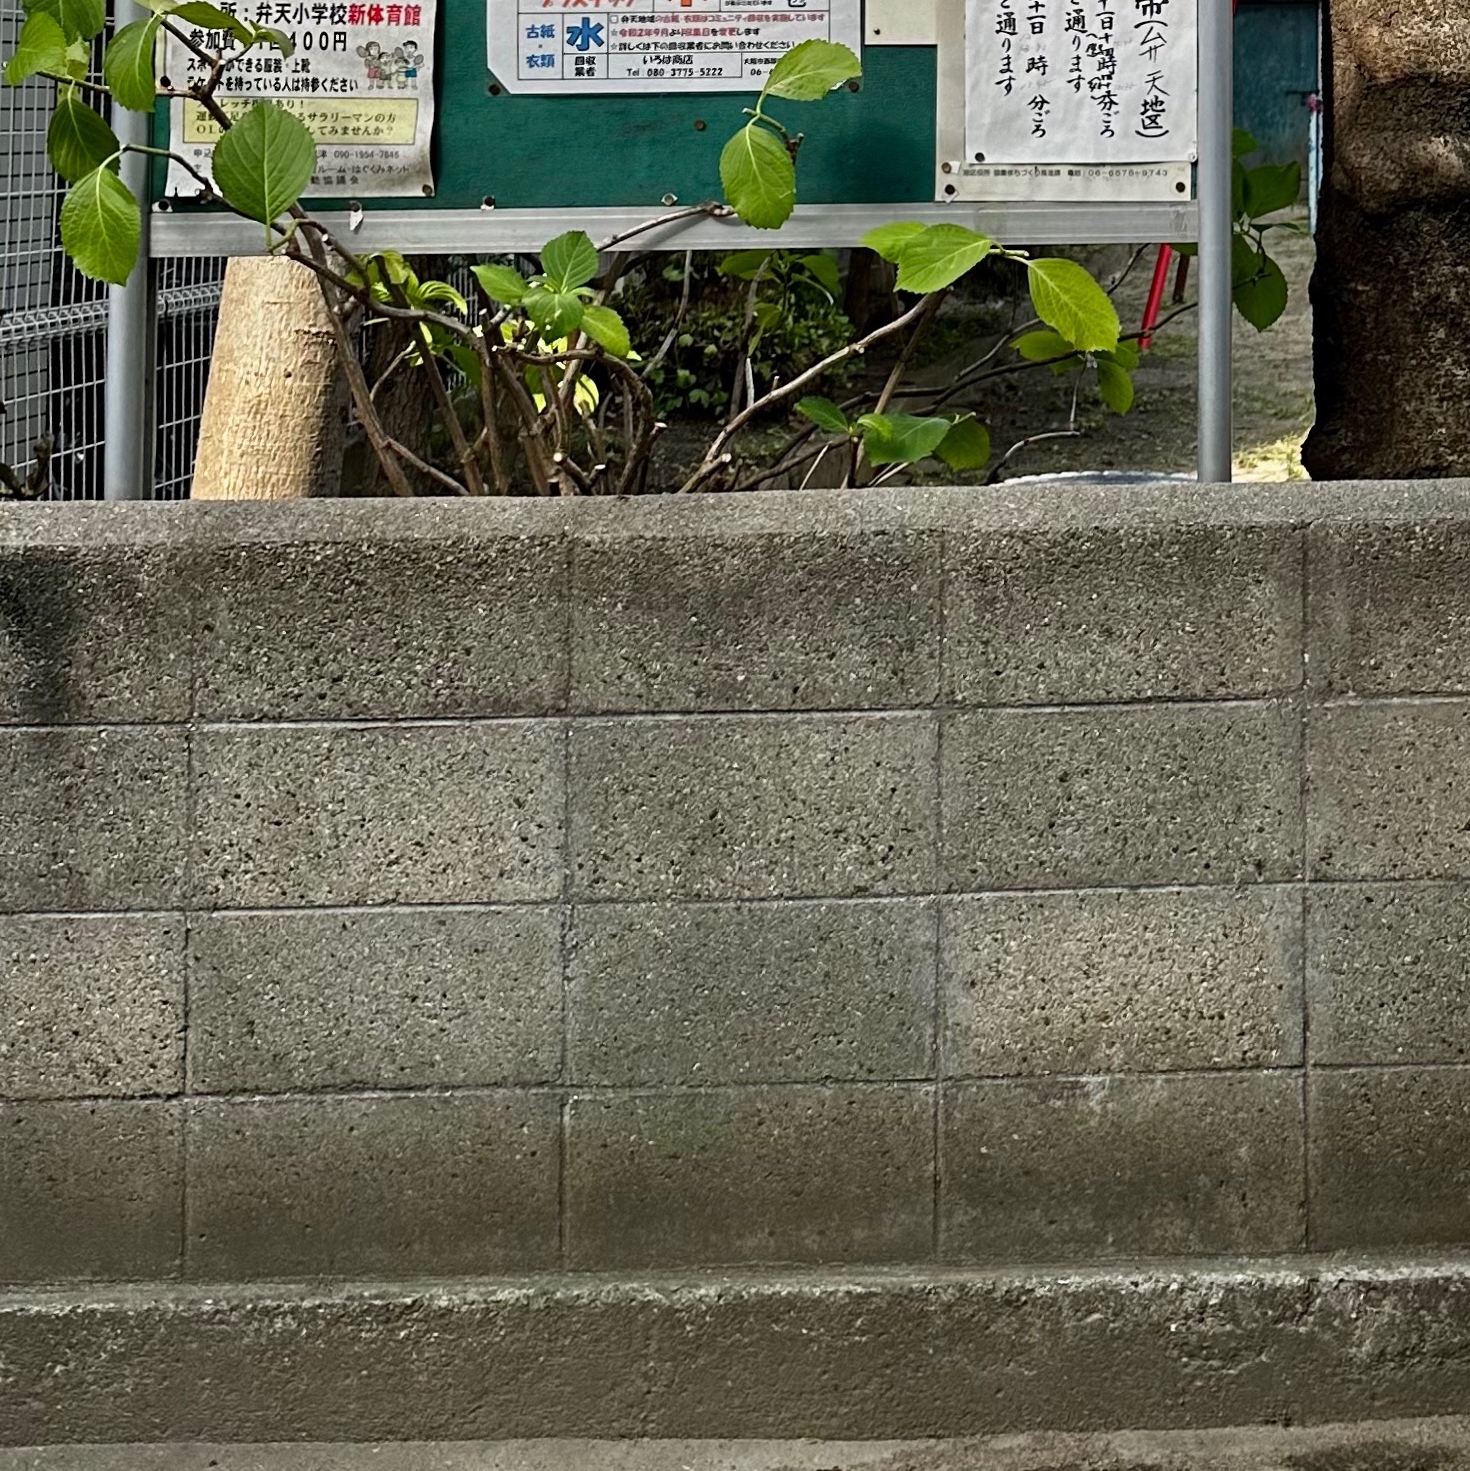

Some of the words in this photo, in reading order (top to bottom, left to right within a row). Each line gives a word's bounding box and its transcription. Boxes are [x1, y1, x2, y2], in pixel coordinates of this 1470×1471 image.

[525, 24, 556, 40] 古紙
[566, 16, 605, 52] 水
[526, 54, 556, 69] 衣類
